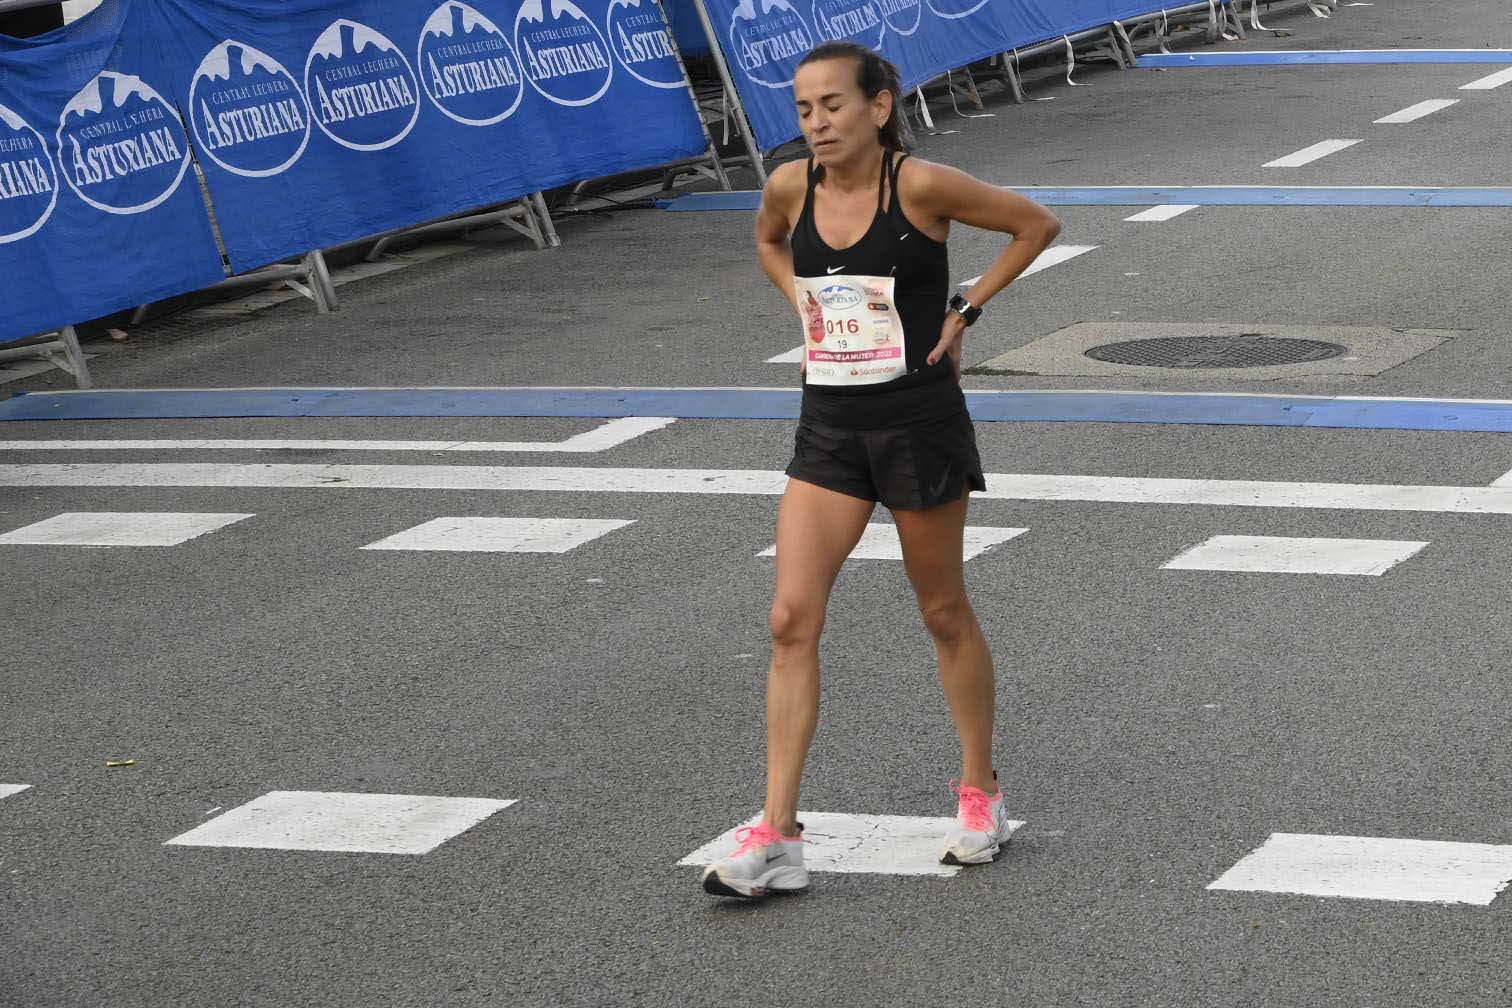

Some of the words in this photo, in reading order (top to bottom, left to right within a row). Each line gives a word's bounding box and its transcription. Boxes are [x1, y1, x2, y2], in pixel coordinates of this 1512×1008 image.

[625, 12, 659, 28] CENTRAL
[531, 28, 563, 44] CENTRAL
[563, 24, 592, 39] LECHERA
[437, 42, 471, 59] CENTRAL
[472, 38, 505, 53] LECHERA
[523, 35, 609, 82] ASTURIANA
[324, 66, 361, 82] CENTRAL
[362, 56, 400, 72] LECHERA
[427, 49, 520, 100] ASTURIANA
[211, 88, 250, 106] CENTRAL
[251, 80, 289, 96] LECHERA
[315, 71, 416, 125] ASTURIANA
[79, 119, 123, 140] CENTRAL
[201, 97, 306, 150] ASTURIANA
[837, 339, 848, 349] 19
